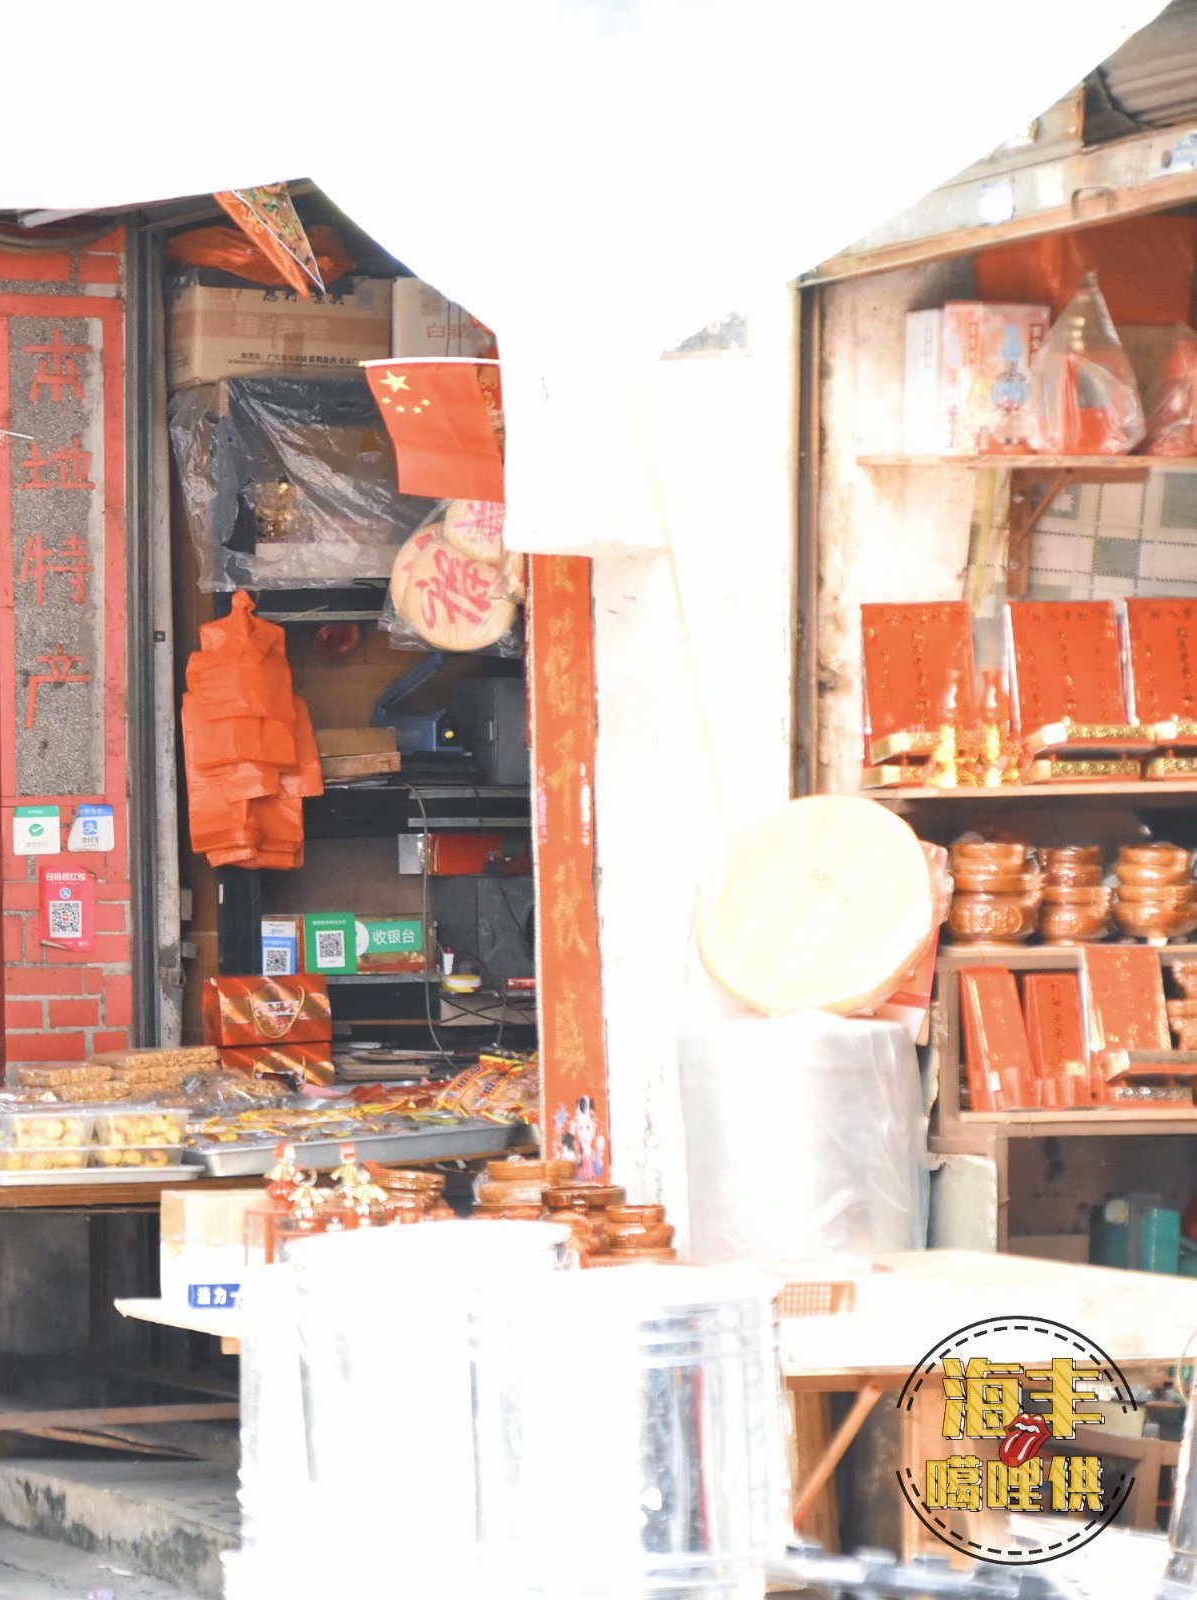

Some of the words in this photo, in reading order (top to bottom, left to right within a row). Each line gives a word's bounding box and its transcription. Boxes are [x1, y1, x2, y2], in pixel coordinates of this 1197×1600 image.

[17, 327, 96, 729] 本地特产
[372, 928, 416, 945] 收银台
